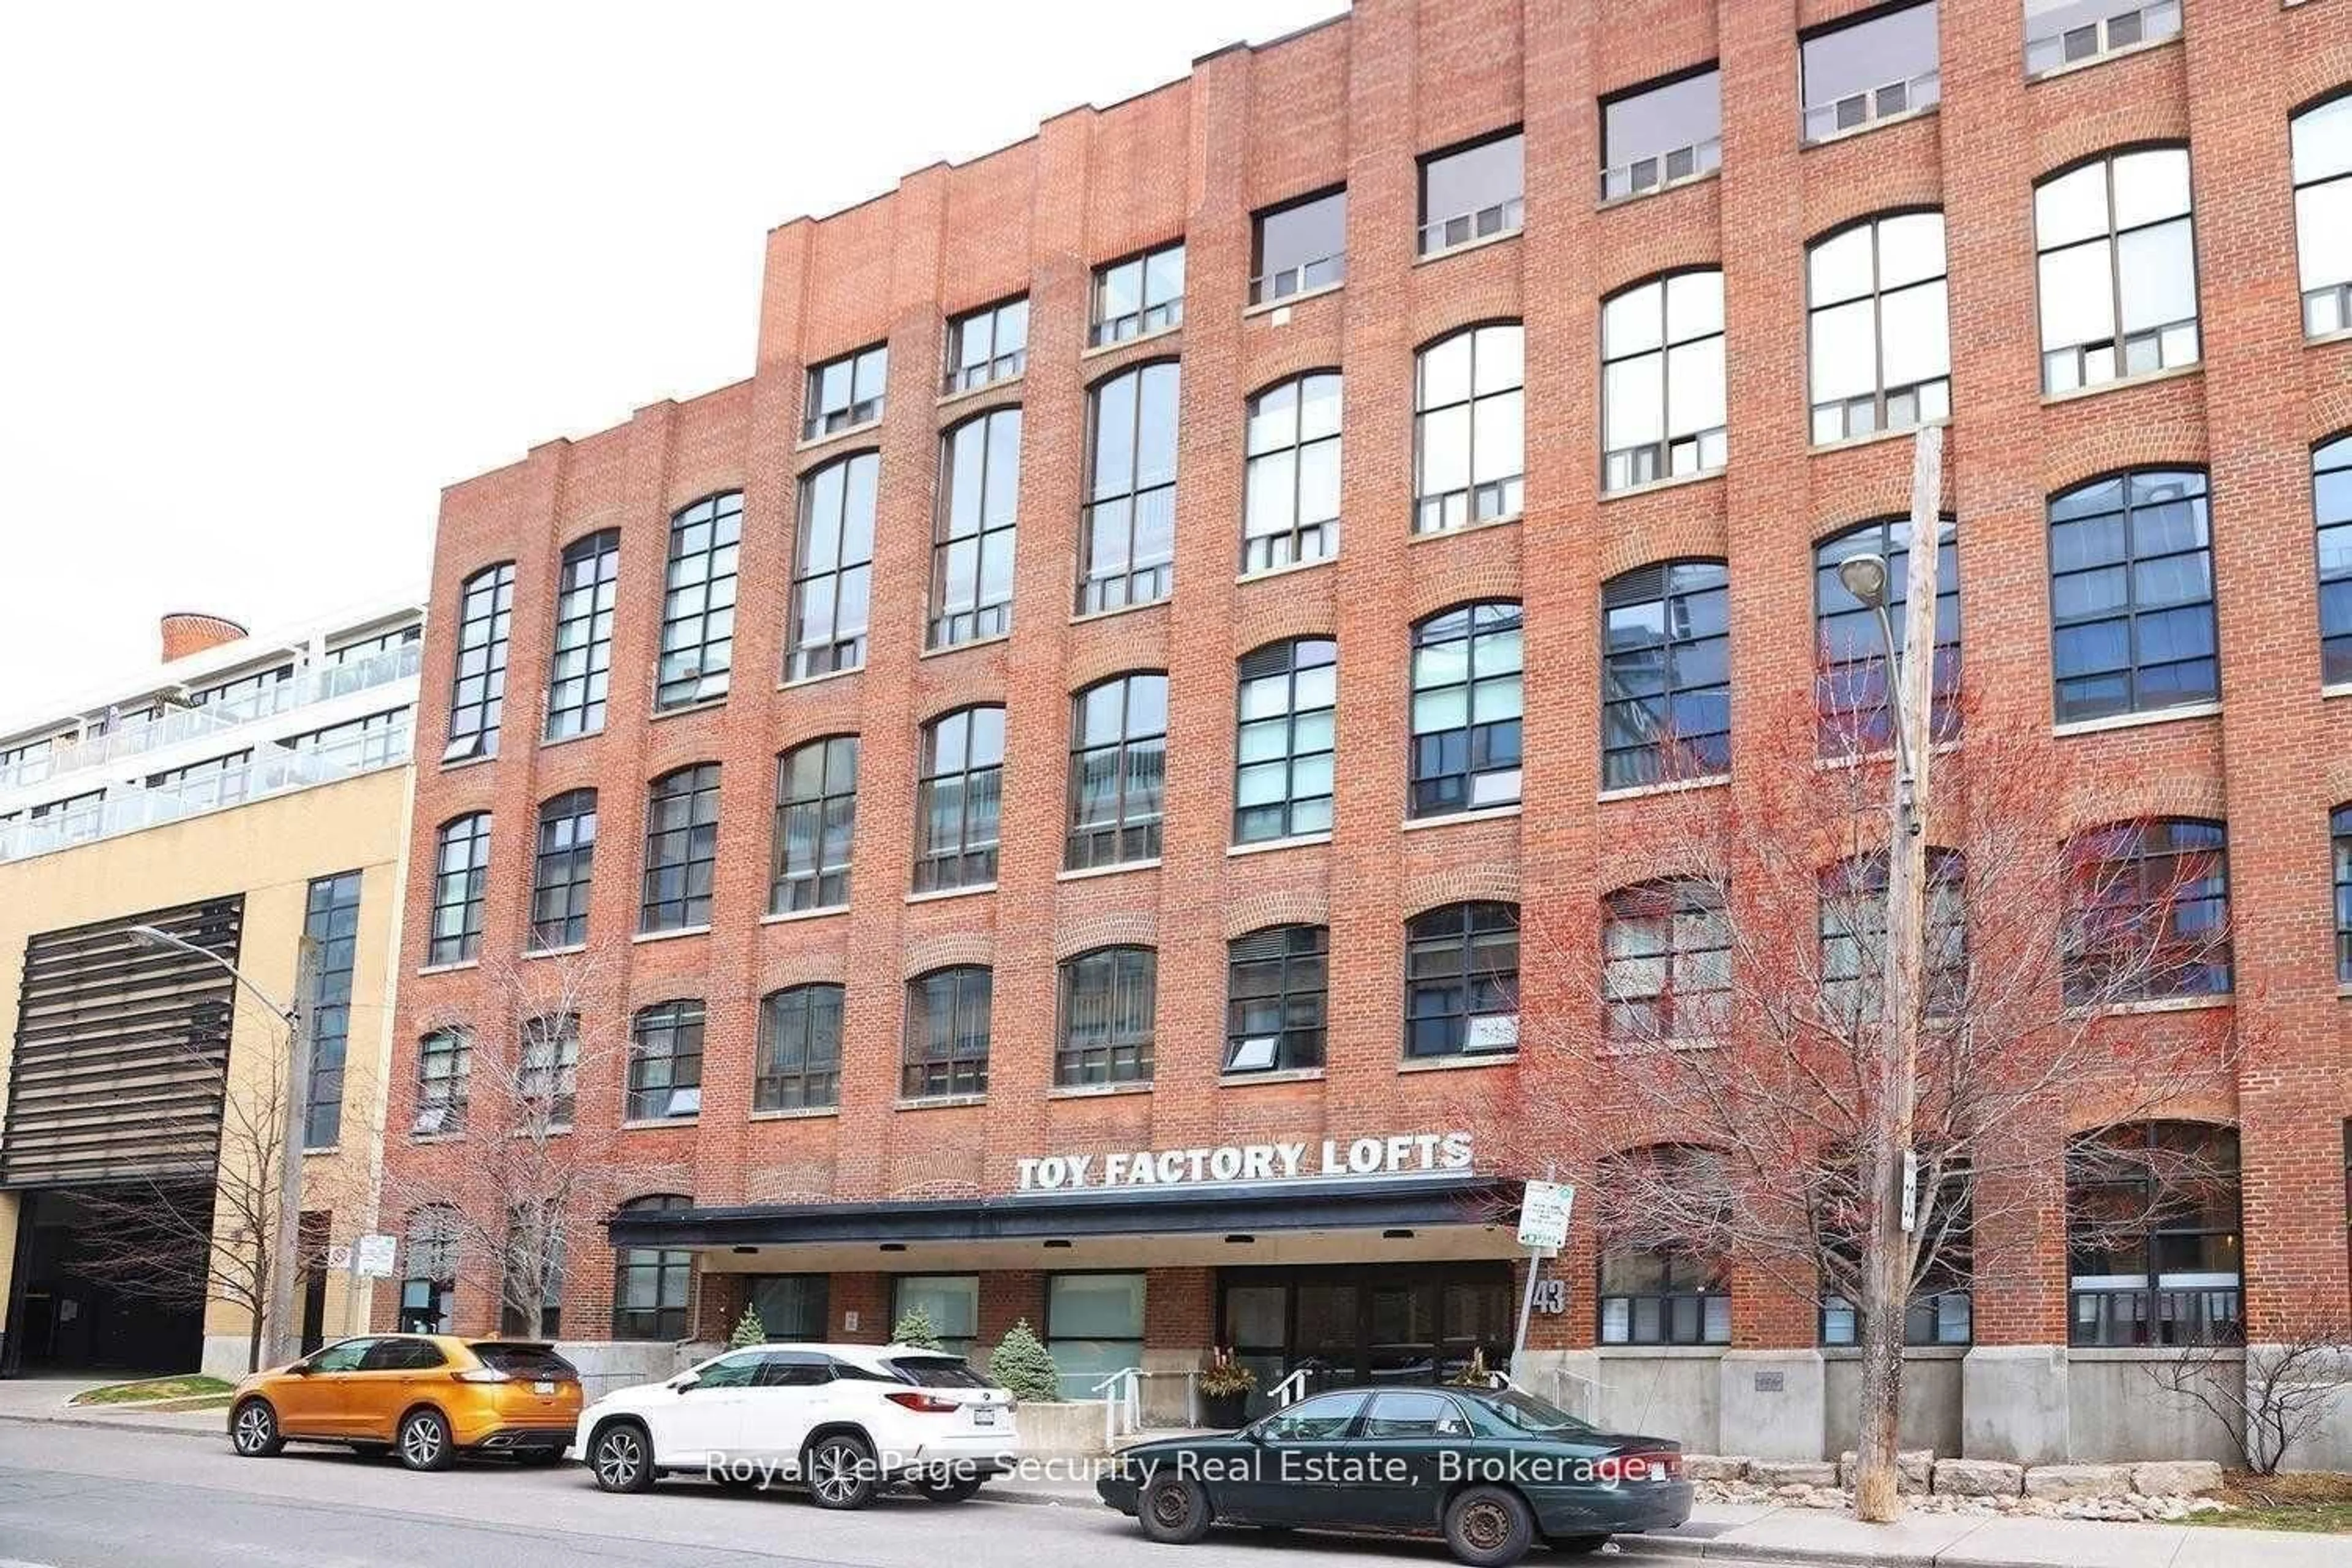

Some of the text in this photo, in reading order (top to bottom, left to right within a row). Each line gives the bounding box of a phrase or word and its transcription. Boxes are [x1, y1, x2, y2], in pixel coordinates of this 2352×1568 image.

[1017, 1133, 1472, 1189] TOY FACTORY LOFTS
[1532, 1280, 1564, 1314] 43
